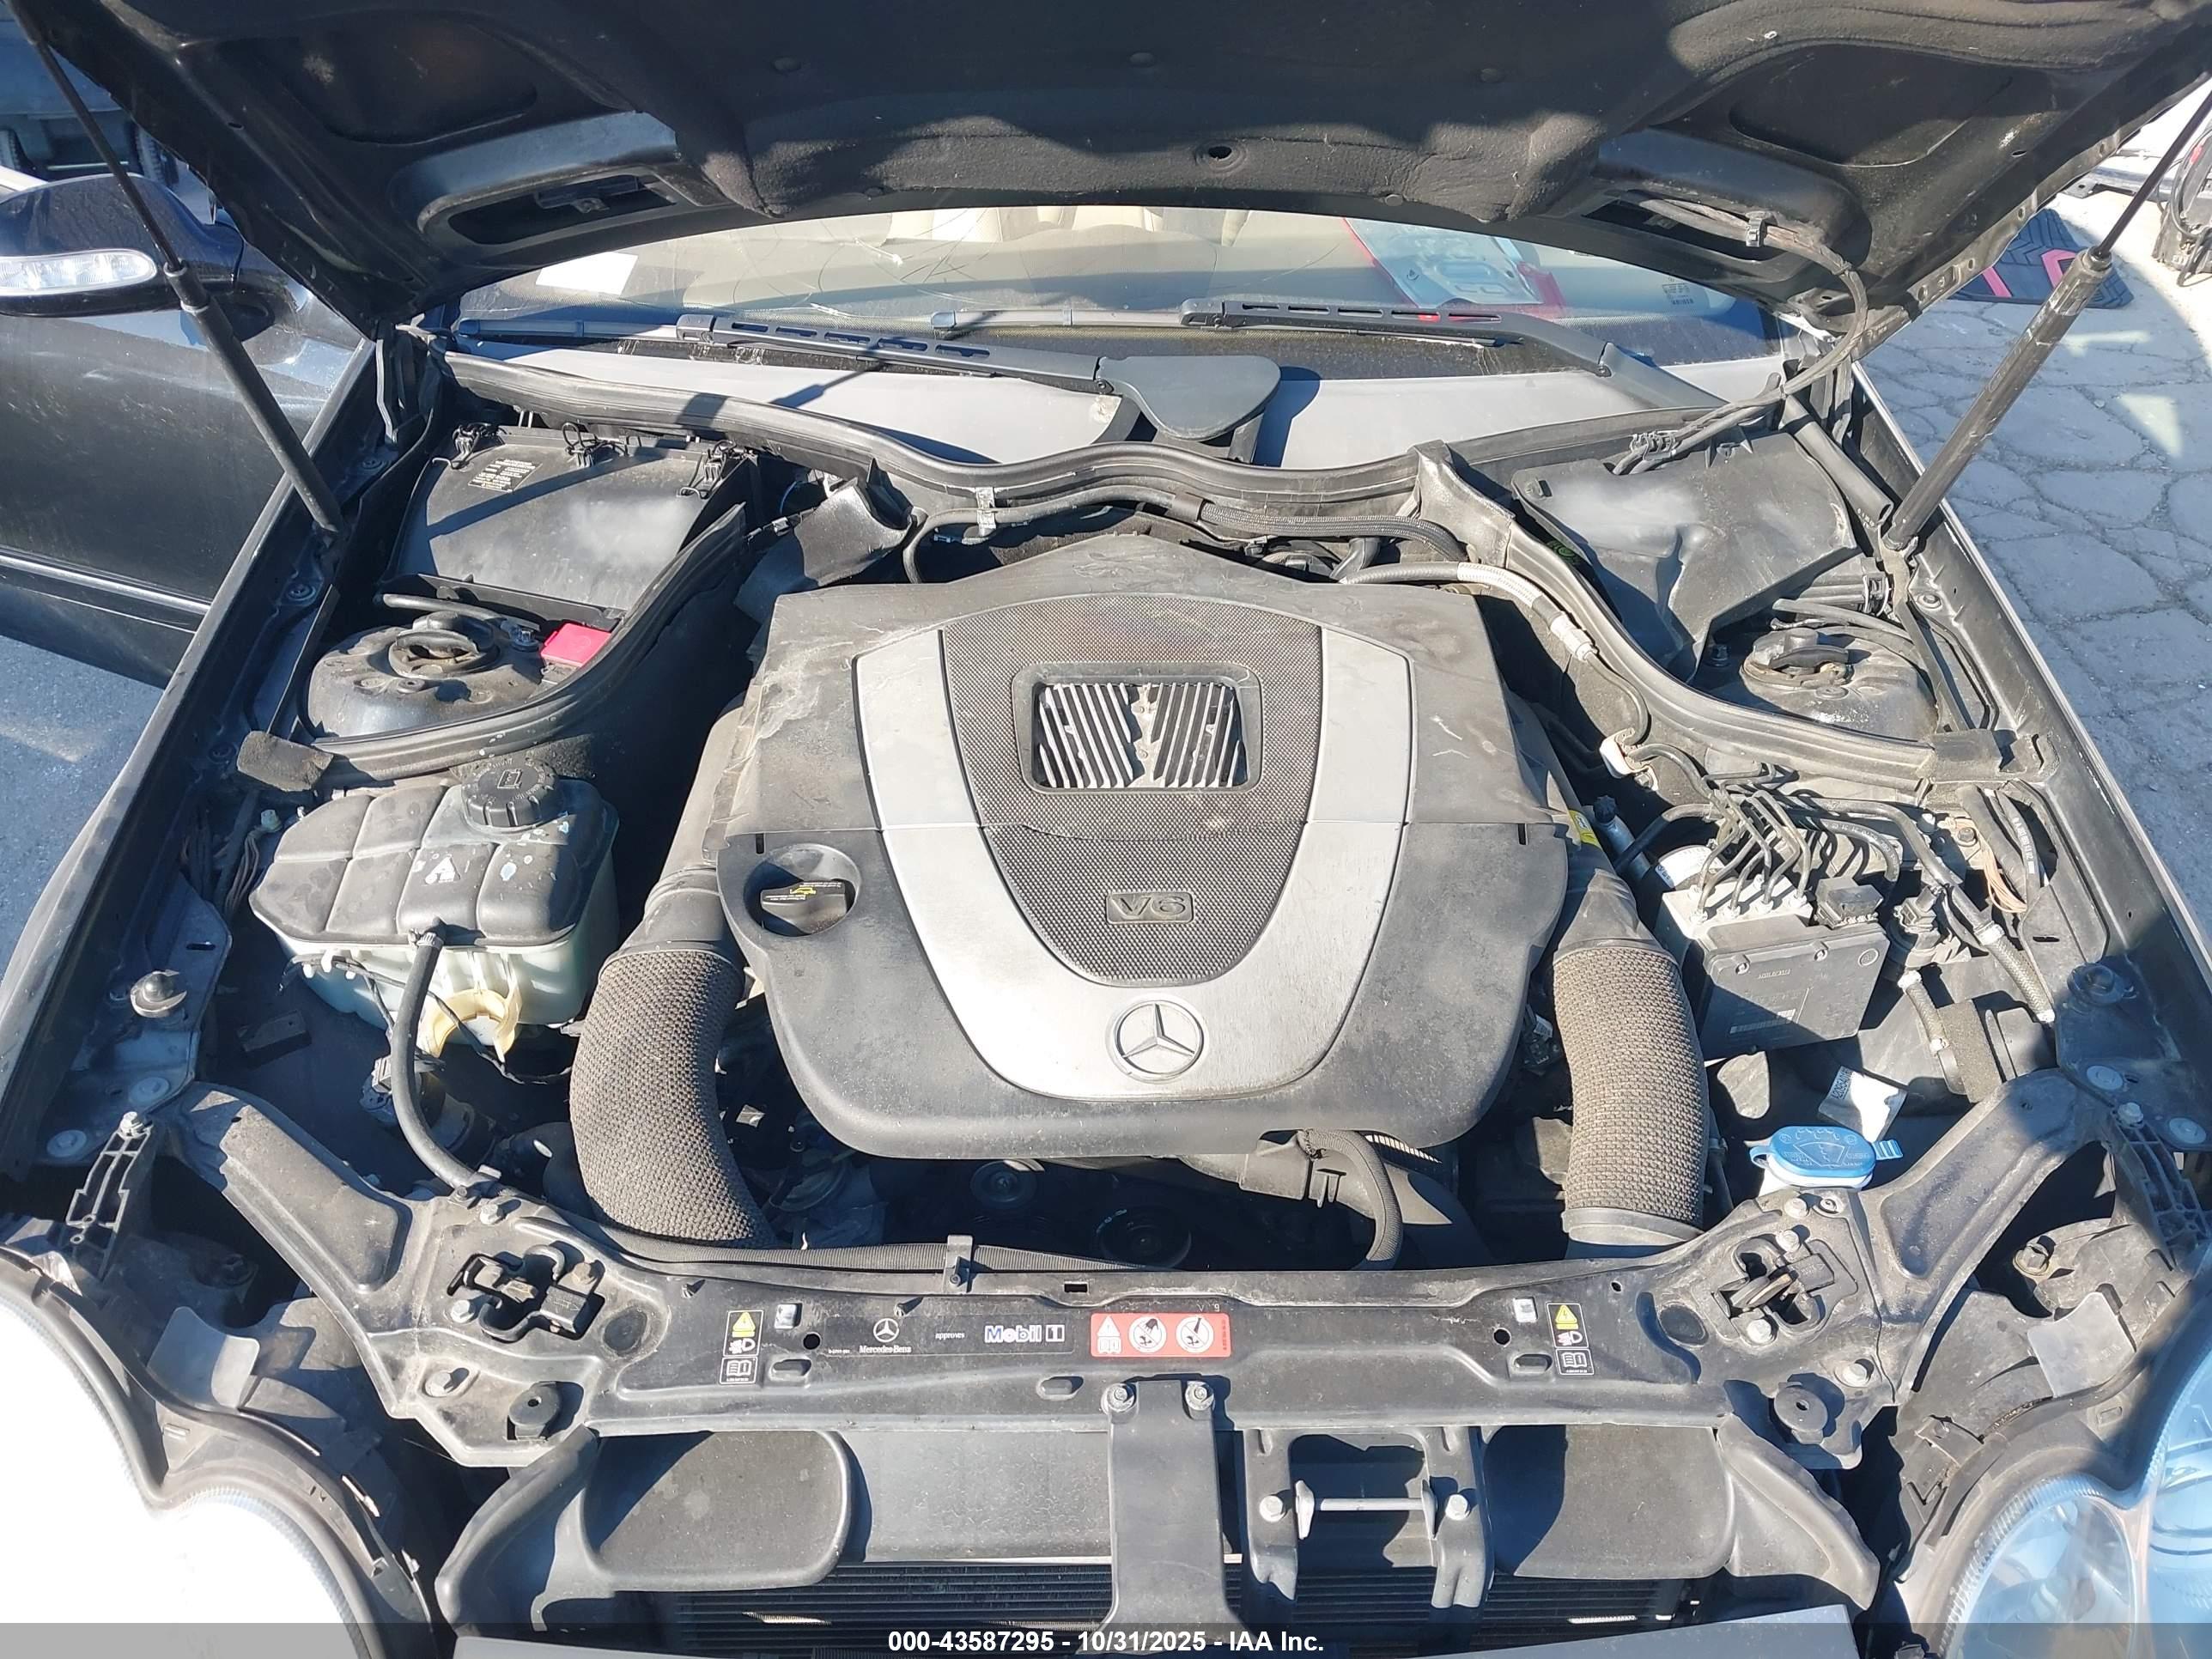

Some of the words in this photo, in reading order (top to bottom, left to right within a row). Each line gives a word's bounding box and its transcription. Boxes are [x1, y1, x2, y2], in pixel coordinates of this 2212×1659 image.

[1112, 894, 1187, 920] V6
[934, 1331, 966, 1340] approves
[984, 1324, 1042, 1343] Mobil
